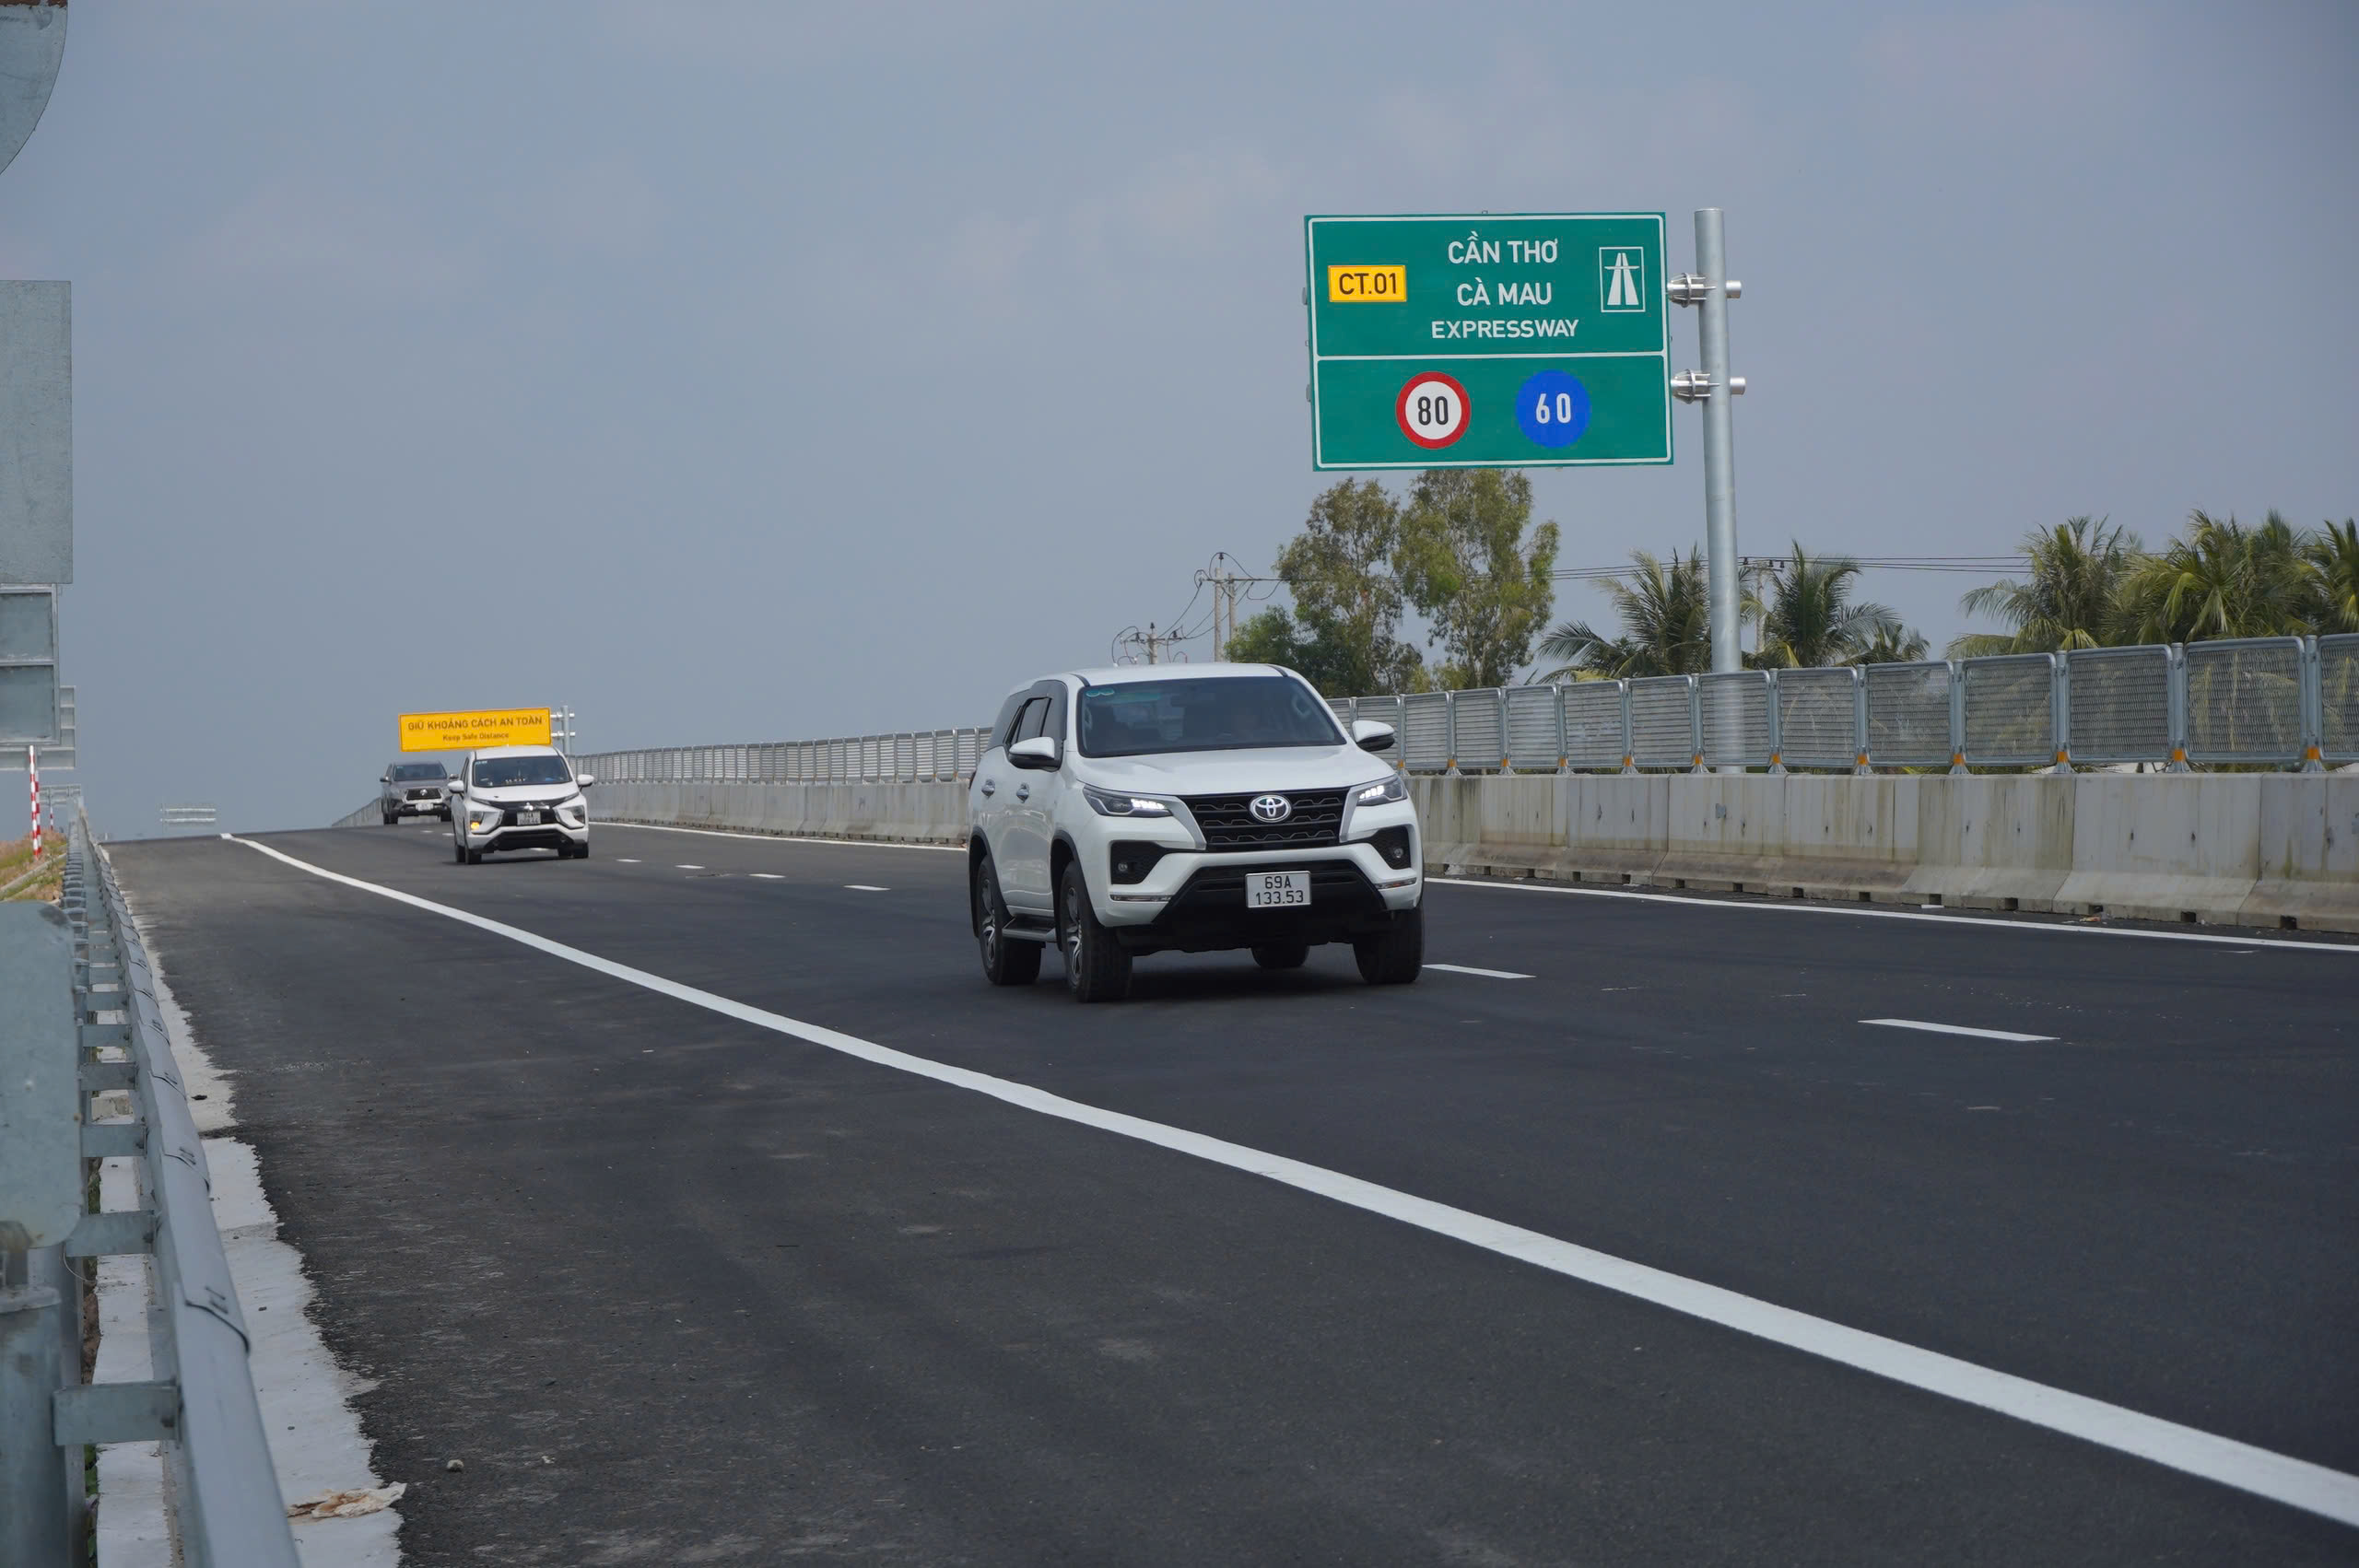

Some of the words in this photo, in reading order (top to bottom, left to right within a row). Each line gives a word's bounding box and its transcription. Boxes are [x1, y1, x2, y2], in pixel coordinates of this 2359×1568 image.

[1448, 230, 1499, 263] CẦN
[1508, 238, 1558, 263] THƠ
[1339, 273, 1397, 295] CT.01
[1456, 277, 1491, 306] CÀ
[1499, 283, 1552, 305] MAU
[1431, 320, 1579, 339] EXPRESSWAY
[1417, 396, 1449, 427] 80
[1535, 393, 1571, 424] 60
[472, 715, 497, 728] CÁCH
[500, 718, 513, 726] AN
[516, 715, 542, 725] TOÀN
[479, 731, 509, 740] Distance
[1264, 875, 1291, 889] 69A
[1256, 890, 1303, 905] 133.53
